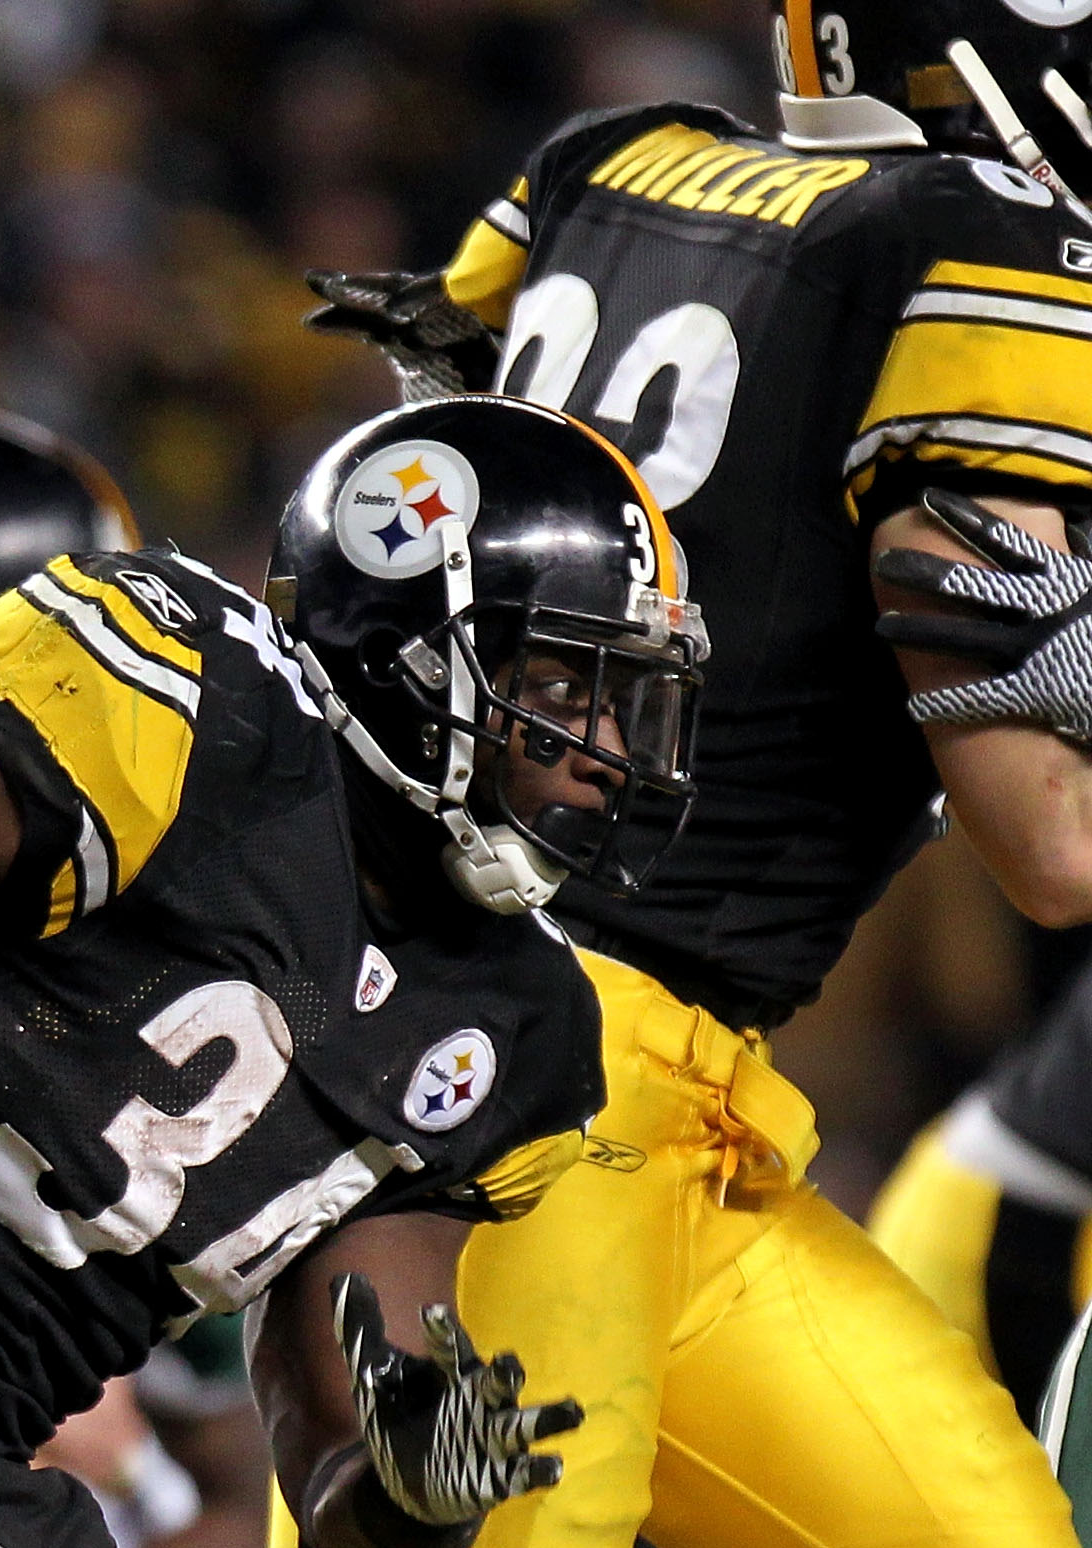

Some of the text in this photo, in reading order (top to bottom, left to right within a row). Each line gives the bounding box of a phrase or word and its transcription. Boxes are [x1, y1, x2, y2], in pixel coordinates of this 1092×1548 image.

[775, 12, 857, 96] 83
[588, 121, 871, 229] MILLER
[353, 491, 397, 508] Steelers
